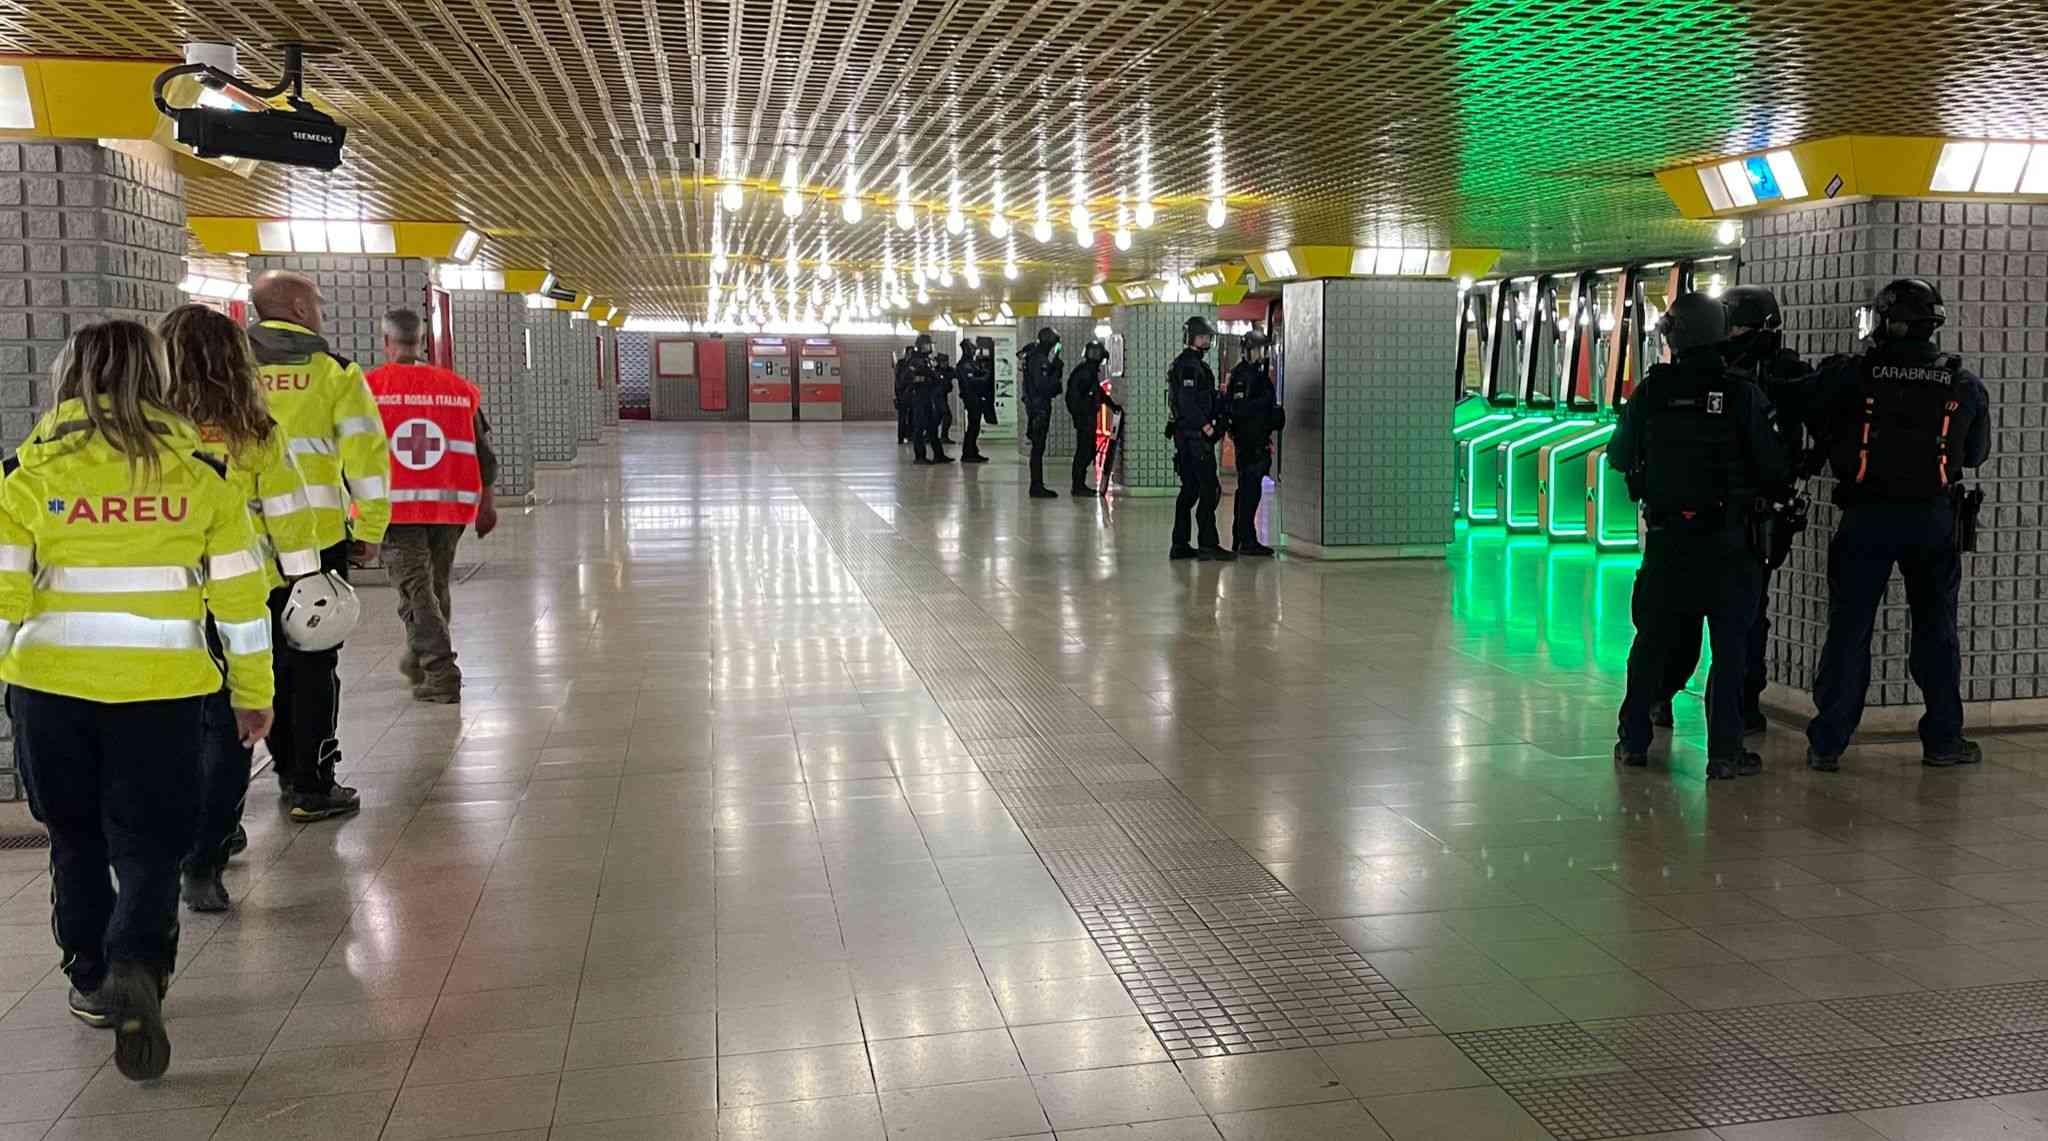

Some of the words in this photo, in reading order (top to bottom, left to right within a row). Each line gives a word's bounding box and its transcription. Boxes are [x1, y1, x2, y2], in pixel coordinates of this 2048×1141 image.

[293, 131, 333, 144] SIEMENS
[257, 373, 311, 391] REU
[1872, 365, 1953, 385] CARABINIERI
[404, 394, 433, 406] ROSSA
[67, 496, 189, 524] AREU
